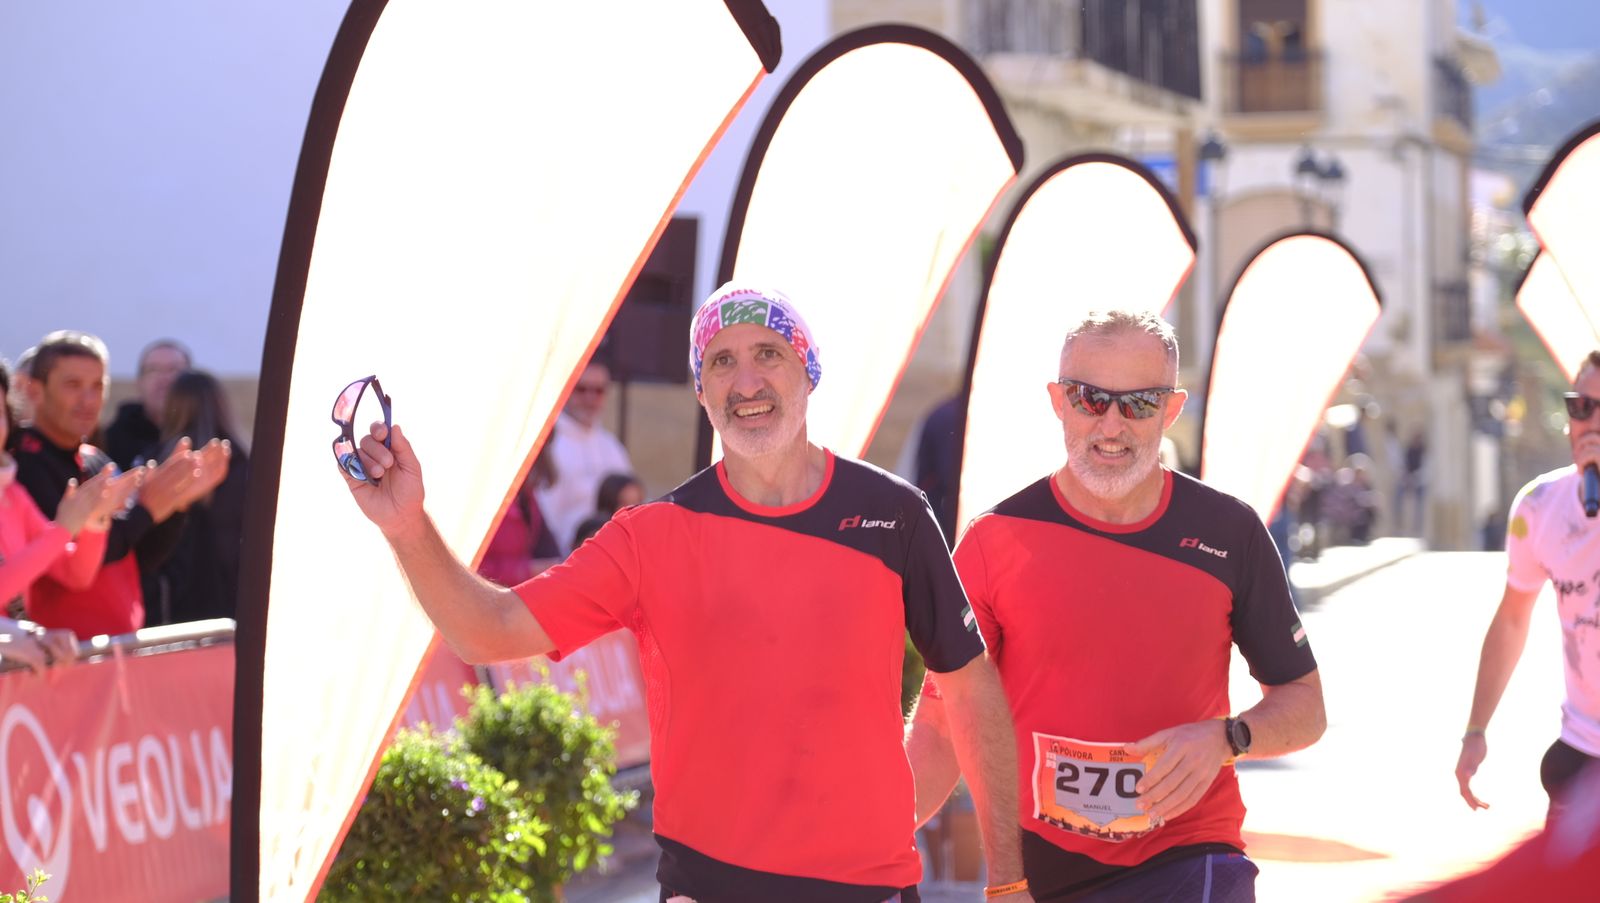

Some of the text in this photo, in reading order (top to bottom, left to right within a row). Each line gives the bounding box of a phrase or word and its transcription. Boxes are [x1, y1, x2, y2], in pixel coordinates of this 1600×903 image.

[72, 726, 233, 853] VEOLIA
[1056, 762, 1143, 798] 270
[1082, 803, 1113, 811] MANUEL
